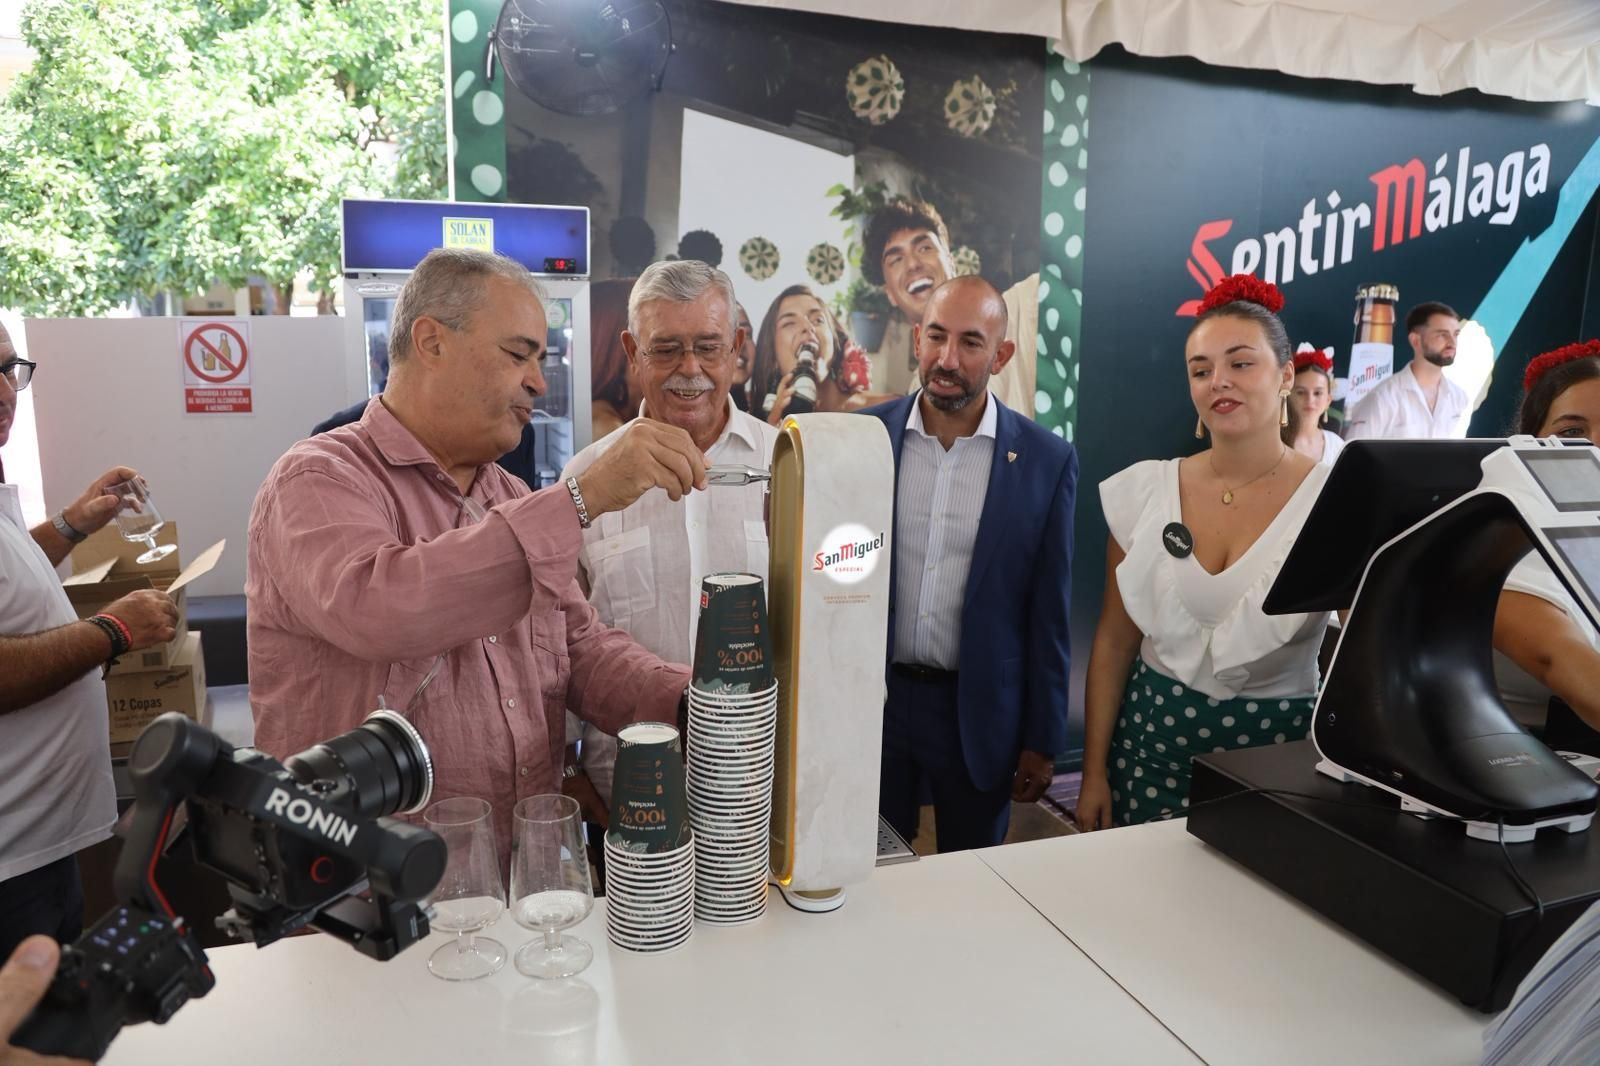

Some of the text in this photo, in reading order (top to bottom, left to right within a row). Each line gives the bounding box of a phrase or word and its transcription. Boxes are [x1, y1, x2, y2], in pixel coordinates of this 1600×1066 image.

[450, 222, 487, 236] SOLAN
[813, 532, 884, 571] SanMiguel
[113, 698, 163, 713] 12 Copas
[264, 787, 358, 847] RONIN
